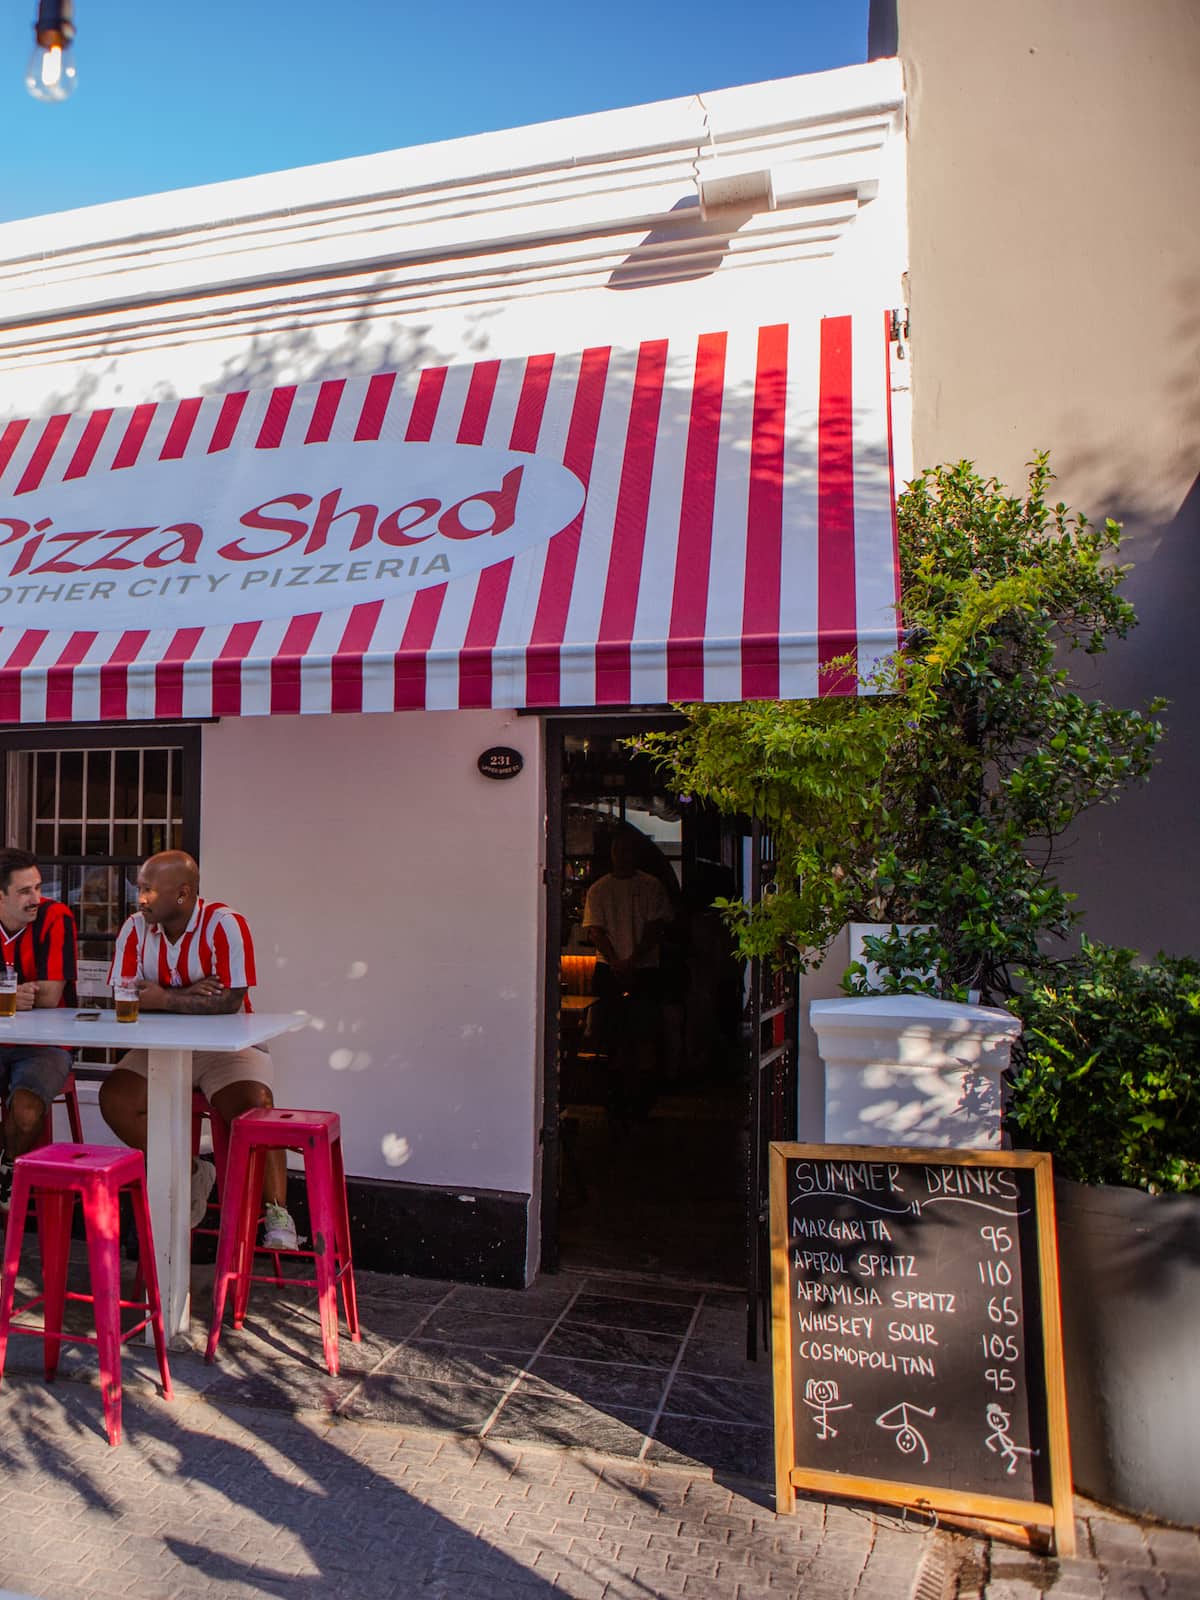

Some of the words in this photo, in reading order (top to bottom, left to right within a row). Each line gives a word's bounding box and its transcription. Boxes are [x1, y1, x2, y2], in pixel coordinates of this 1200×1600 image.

[217, 464, 526, 562] Shed
[128, 573, 232, 598] CITY
[240, 553, 453, 591] PIZZERIA
[490, 755, 510, 766] 231
[796, 1163, 904, 1192] SUMMER
[924, 1166, 1018, 1199] DRINKS
[792, 1217, 892, 1241] MARGARITA
[980, 1226, 1013, 1252] 95
[794, 1249, 848, 1275] APEROL
[858, 1254, 918, 1277] SPRITZ
[978, 1260, 1012, 1287] 110
[891, 1291, 956, 1313] SPRITZ
[988, 1296, 1018, 1325] 65
[798, 1312, 872, 1338] WHISKEY
[888, 1322, 939, 1345] SOUR
[981, 1334, 1019, 1362] 105
[799, 1341, 935, 1377] COSMOPOLITAN
[985, 1368, 1016, 1392] 95
